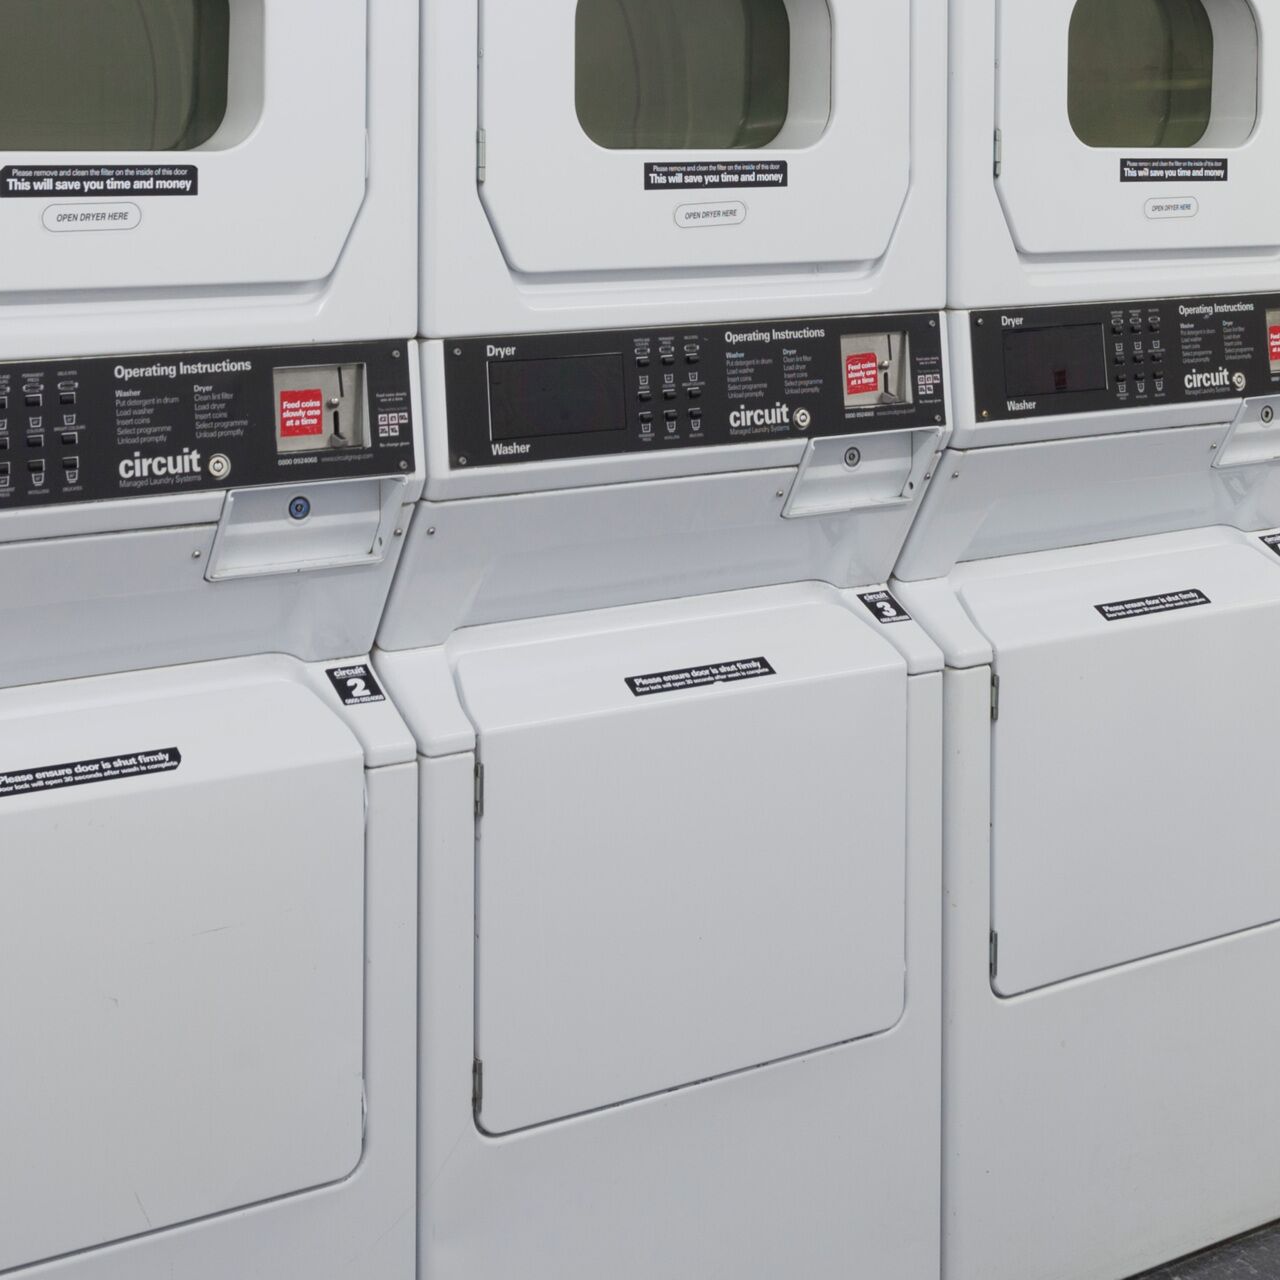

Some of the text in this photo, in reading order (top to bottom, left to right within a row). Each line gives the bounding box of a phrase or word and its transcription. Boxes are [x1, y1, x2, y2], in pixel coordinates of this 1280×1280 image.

[7, 178, 191, 192] This will save you time and money
[649, 172, 783, 185] This will save you time and money
[57, 212, 128, 222] OPEN DRYER HERE
[1179, 302, 1254, 317] Operating Instructions
[1001, 316, 1023, 326] Dryer
[725, 327, 825, 345] Operating Instructions
[487, 345, 516, 358] Dryer
[114, 359, 252, 380] Operating Instructions
[1184, 367, 1229, 389] circuit
[1007, 401, 1036, 411] Washer
[283, 409, 305, 418] slowly
[729, 402, 789, 427] circuit
[491, 443, 530, 456] Washer
[119, 447, 201, 478] circuit
[119, 475, 201, 488] Managed Laundry Systems
[876, 602, 896, 616] 3
[334, 666, 366, 676] circuit
[347, 678, 371, 697] 2
[36, 769, 72, 779] ensure
[75, 764, 99, 773] door
[101, 761, 111, 769] is
[113, 758, 137, 767] shut
[138, 752, 169, 764] firmly
